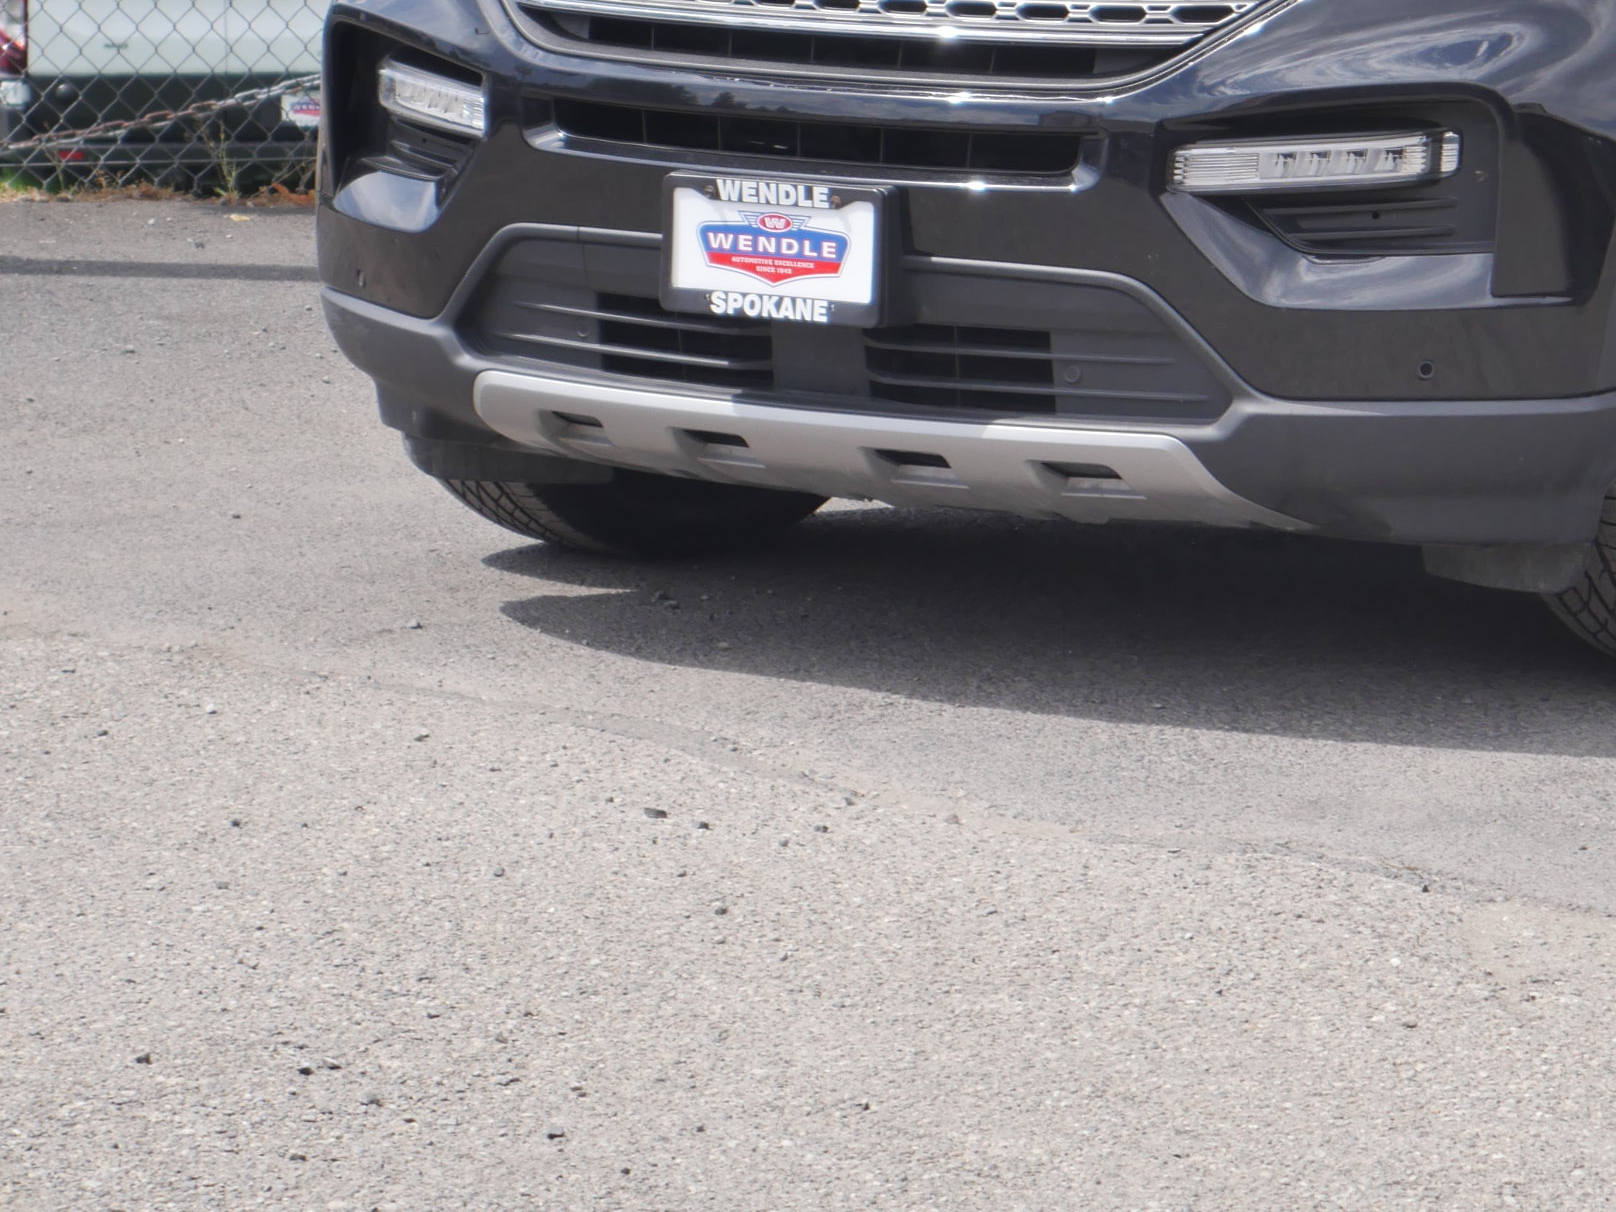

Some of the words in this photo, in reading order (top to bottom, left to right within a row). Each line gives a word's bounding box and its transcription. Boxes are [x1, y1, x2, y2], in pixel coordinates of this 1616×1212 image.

[716, 178, 831, 209] WENDLE
[763, 216, 786, 229] W
[707, 231, 837, 259] WENDLE
[731, 256, 773, 266] AUTOMOTIVE
[774, 259, 815, 269] EXCELLENCE
[709, 290, 829, 323] SPOKANE
